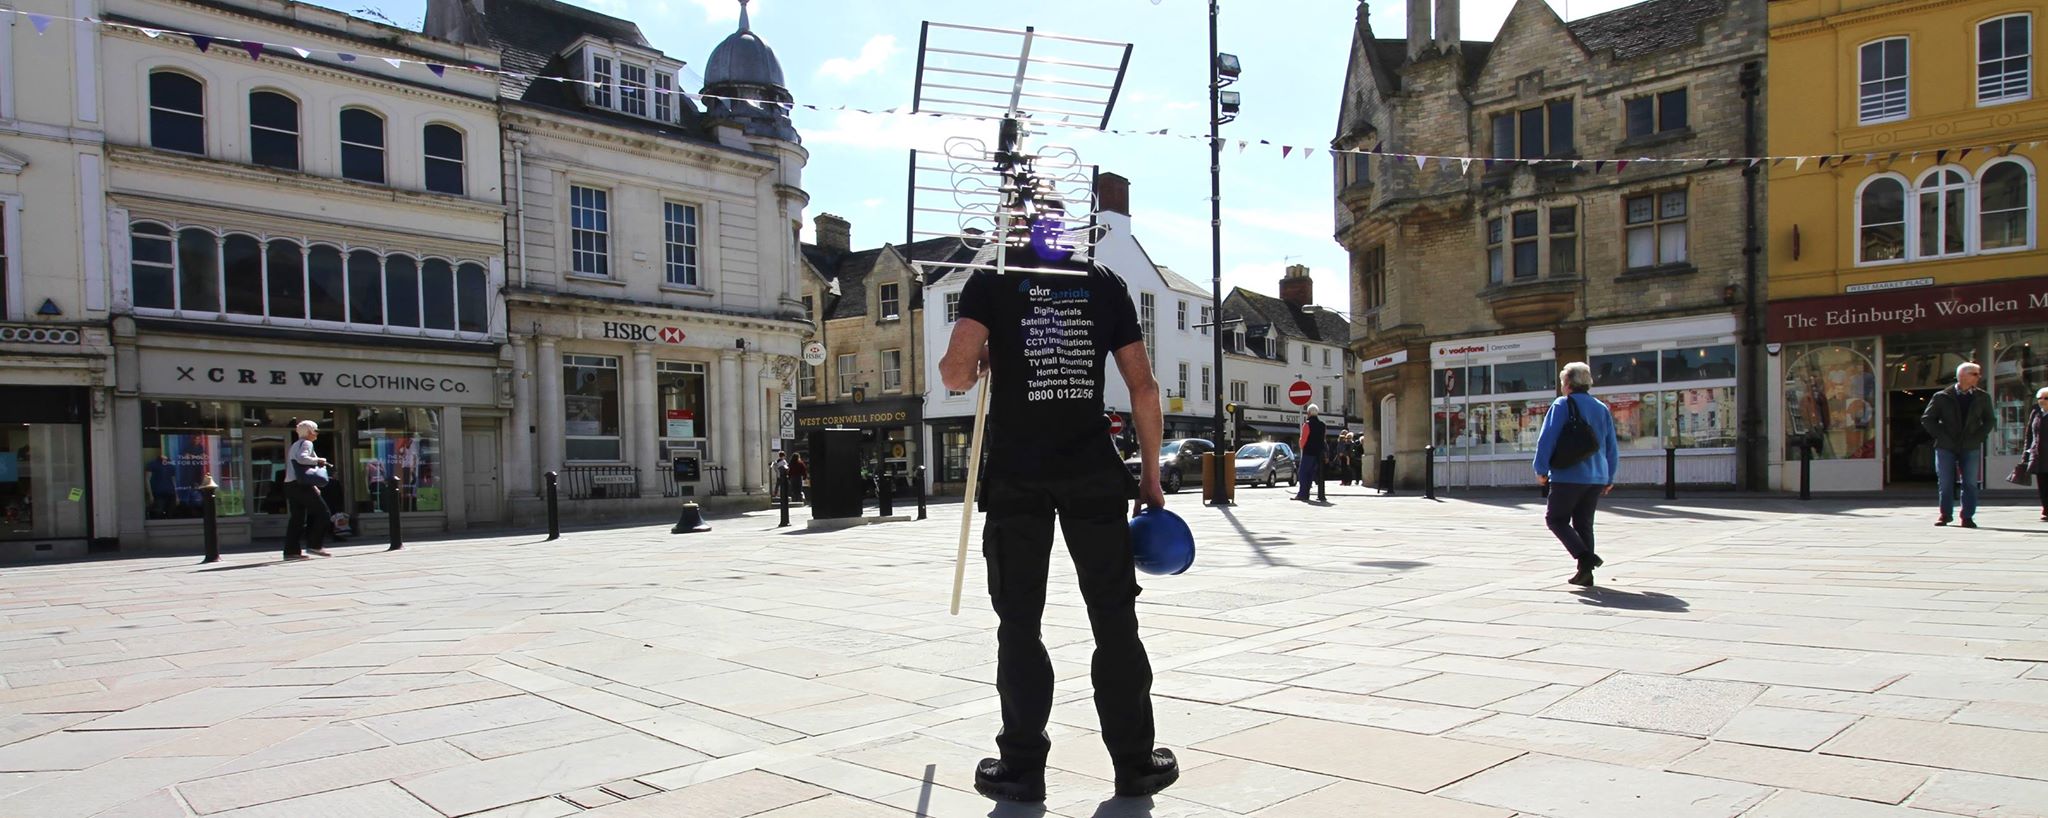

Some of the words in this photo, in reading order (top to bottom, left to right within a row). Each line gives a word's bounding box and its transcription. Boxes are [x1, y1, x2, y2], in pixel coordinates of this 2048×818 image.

[1872, 281, 1903, 289] MARKET
[1054, 308, 1082, 316] Aerials
[1784, 313, 1818, 328] The
[1825, 303, 1927, 324] Edinburgh
[1934, 296, 2018, 316] Woollen
[603, 321, 656, 342] HSBC
[1029, 327, 1044, 337] Sky
[1026, 337, 1048, 346] CCTV
[1024, 347, 1054, 356] Satellite
[1029, 359, 1040, 367] TV
[1042, 357, 1058, 366] Wall
[1060, 357, 1093, 368] Mounting
[1036, 368, 1058, 376] Home
[1060, 367, 1088, 376] Cinema
[207, 367, 324, 386] CREW
[336, 373, 435, 392] CLOTHING
[440, 378, 470, 392] Co.
[1027, 378, 1068, 388] Telephone
[1070, 377, 1094, 386] Sockets
[1028, 389, 1054, 401] 0800
[800, 418, 820, 426] WEST
[822, 415, 868, 425] CORNWALL
[870, 413, 892, 422] FOOD
